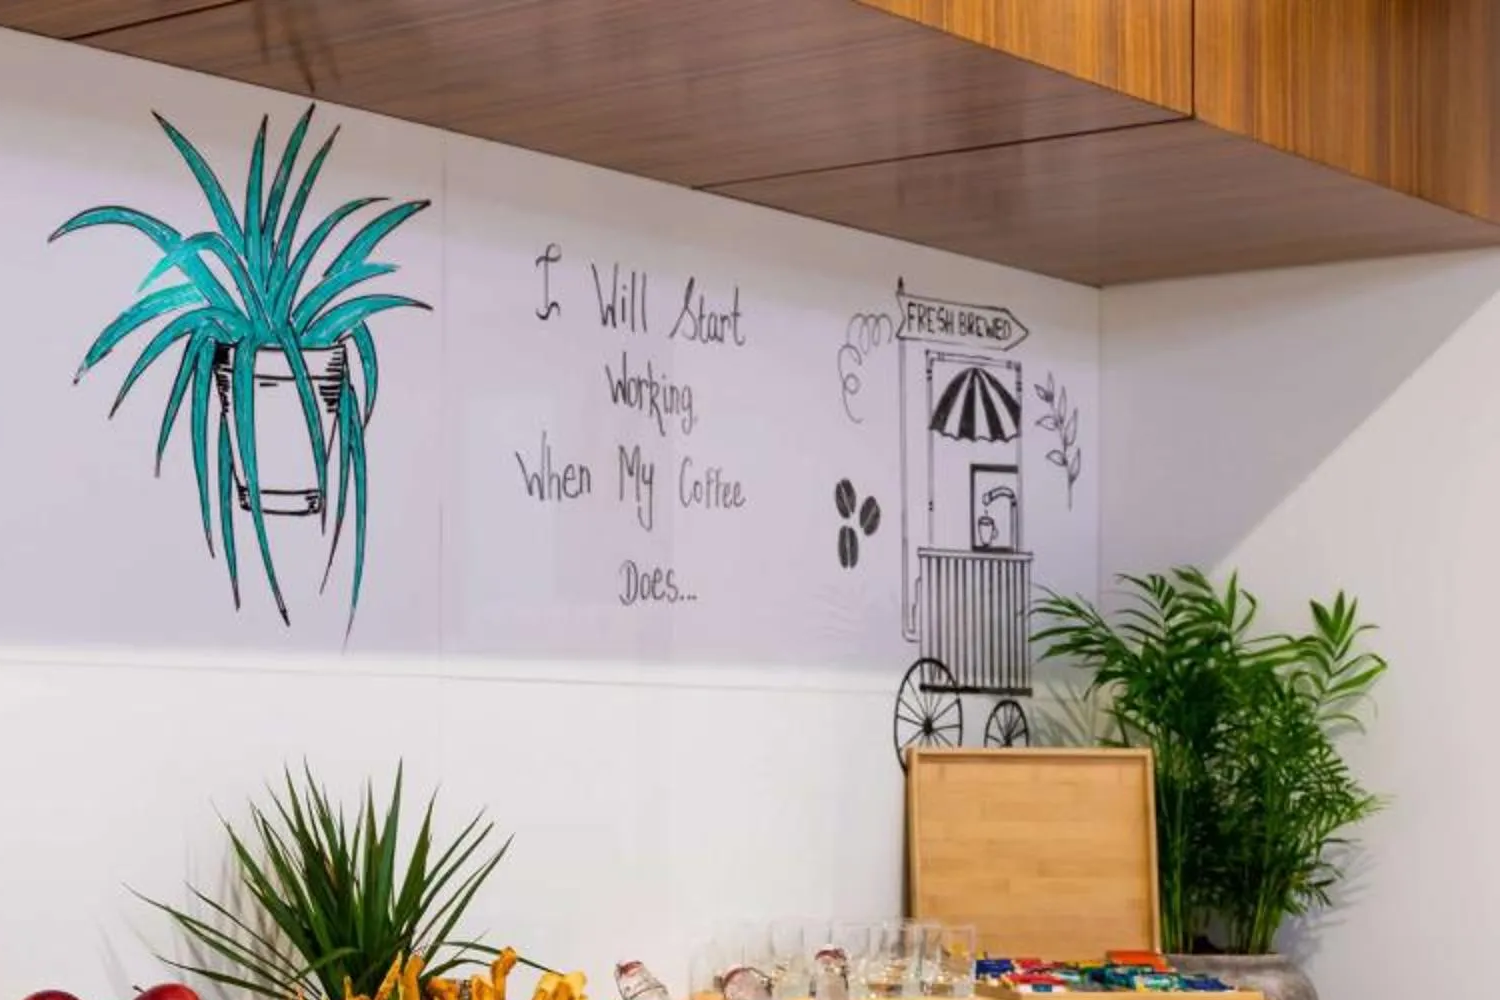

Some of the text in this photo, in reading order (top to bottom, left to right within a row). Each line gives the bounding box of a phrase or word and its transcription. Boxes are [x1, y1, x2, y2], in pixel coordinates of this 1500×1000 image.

[535, 243, 746, 346] I Will Start
[907, 301, 1013, 341] FRESH BREWED
[515, 431, 746, 532] When My Coffee
